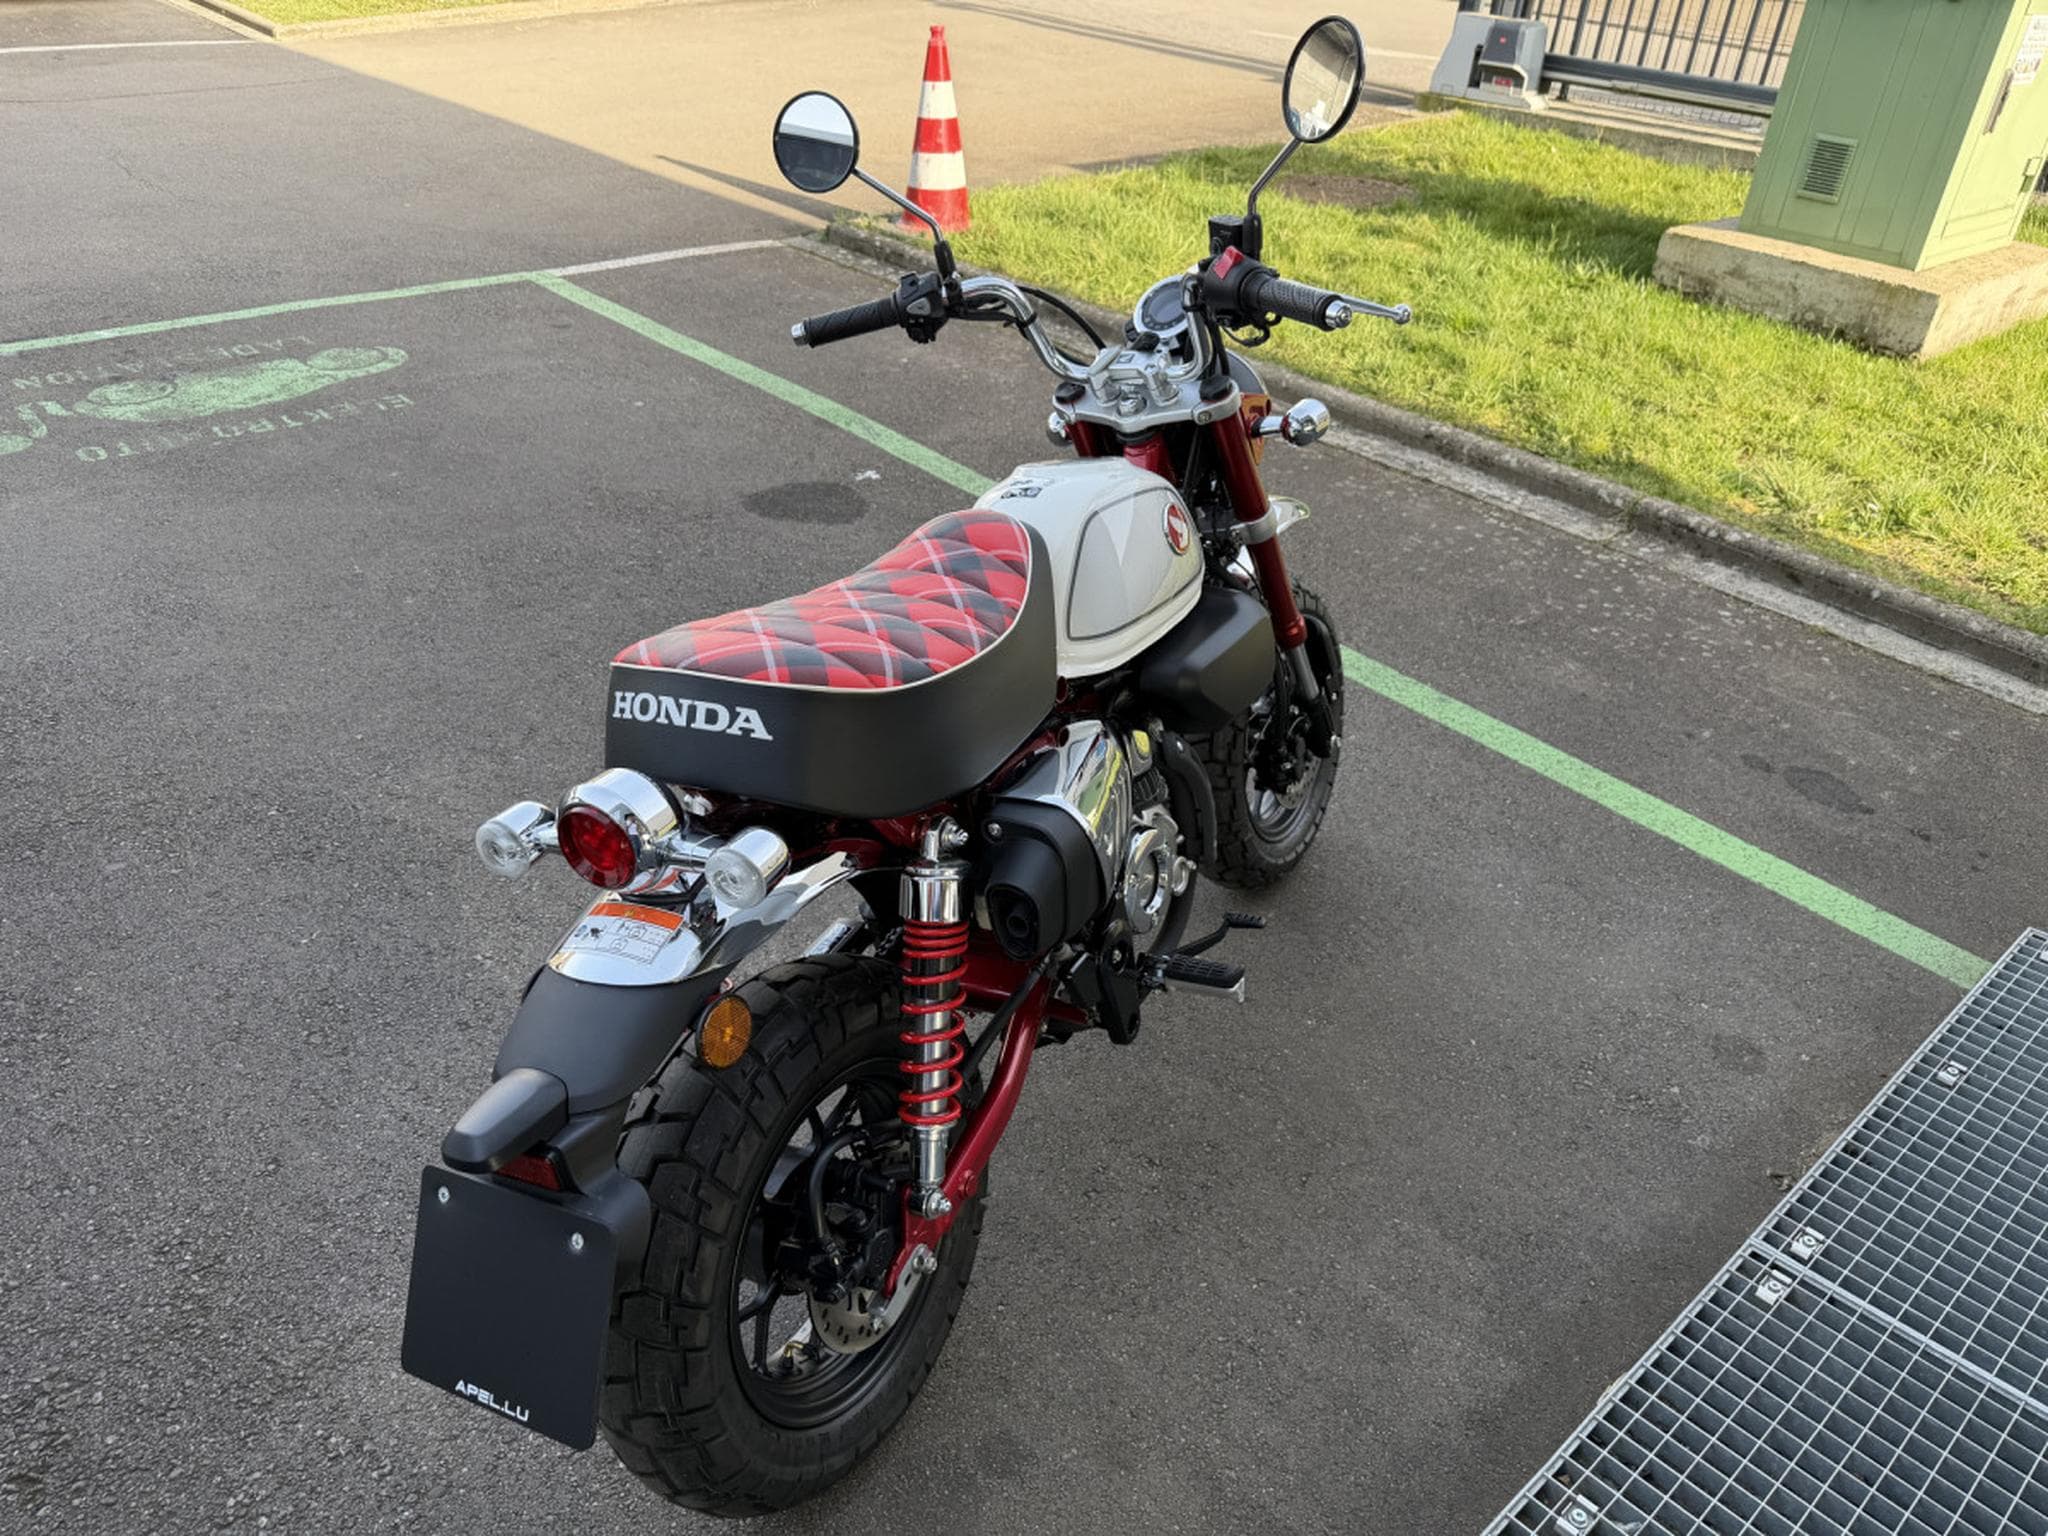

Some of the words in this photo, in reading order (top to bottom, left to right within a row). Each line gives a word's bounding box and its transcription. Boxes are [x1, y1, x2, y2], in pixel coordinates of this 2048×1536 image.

[75, 394, 414, 462] ELEKTROTO
[612, 691, 774, 741] HONDA
[455, 1379, 529, 1422] APEL.LU
